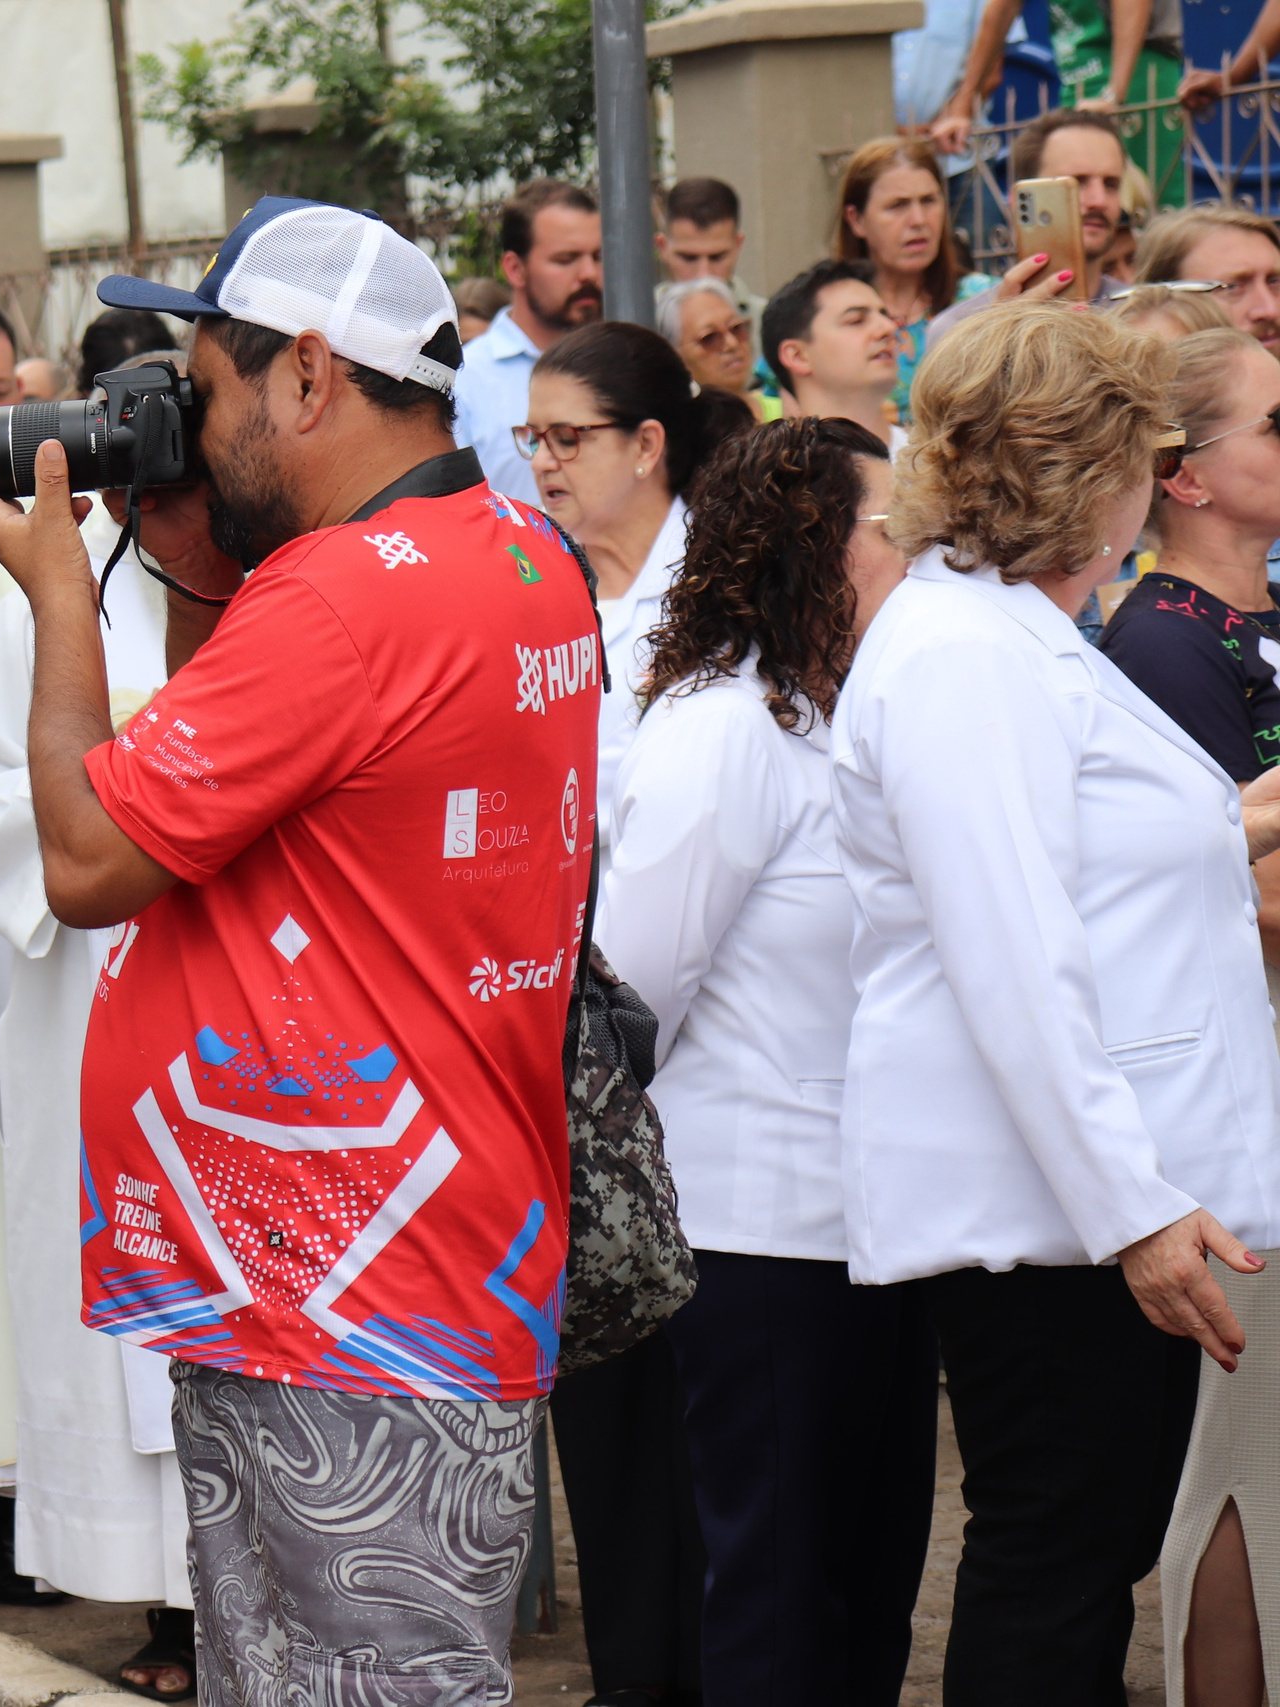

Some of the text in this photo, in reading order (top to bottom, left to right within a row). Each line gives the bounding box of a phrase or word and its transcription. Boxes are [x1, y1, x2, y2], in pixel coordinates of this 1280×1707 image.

[544, 632, 597, 702] HUPI
[173, 719, 198, 740] FME
[154, 744, 220, 791] Municipal de
[163, 731, 214, 769] Fundação
[456, 791, 507, 816] LEO
[453, 824, 530, 854] SOUZA
[442, 861, 529, 884] Arquitetura
[103, 921, 140, 980] PI
[115, 1172, 160, 1207] SONHE
[114, 1200, 162, 1233] TREINE
[113, 1228, 179, 1265] ALCANCE
